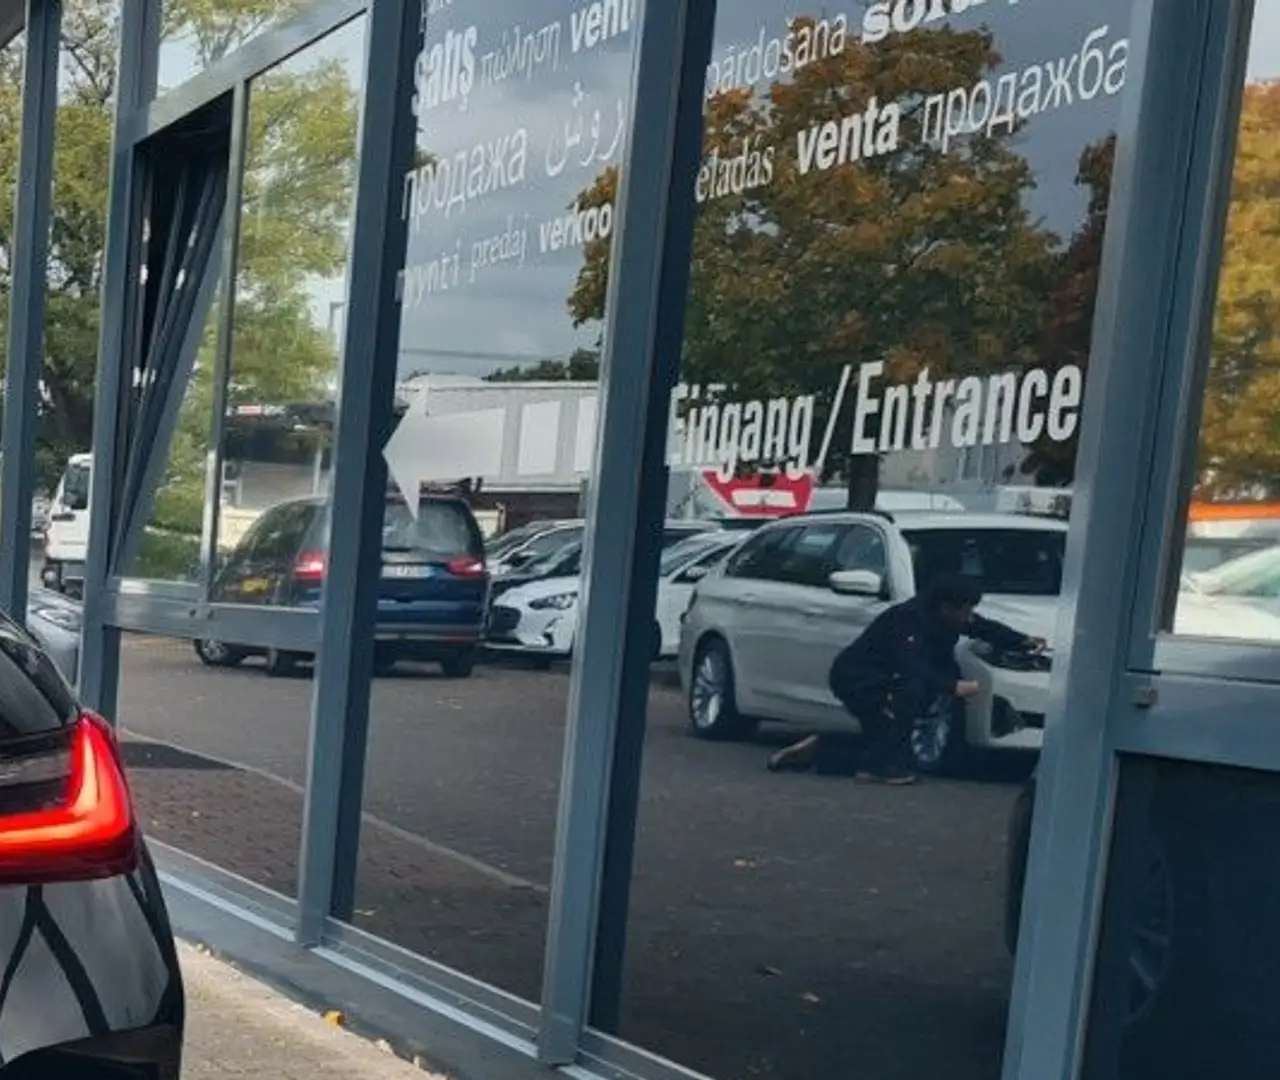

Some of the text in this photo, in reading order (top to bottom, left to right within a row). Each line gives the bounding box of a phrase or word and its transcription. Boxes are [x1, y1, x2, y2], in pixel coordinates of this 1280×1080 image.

[921, 25, 1129, 155] продажба
[401, 127, 527, 235] продажа
[694, 97, 900, 203] eladás venta
[470, 213, 529, 283] predaj
